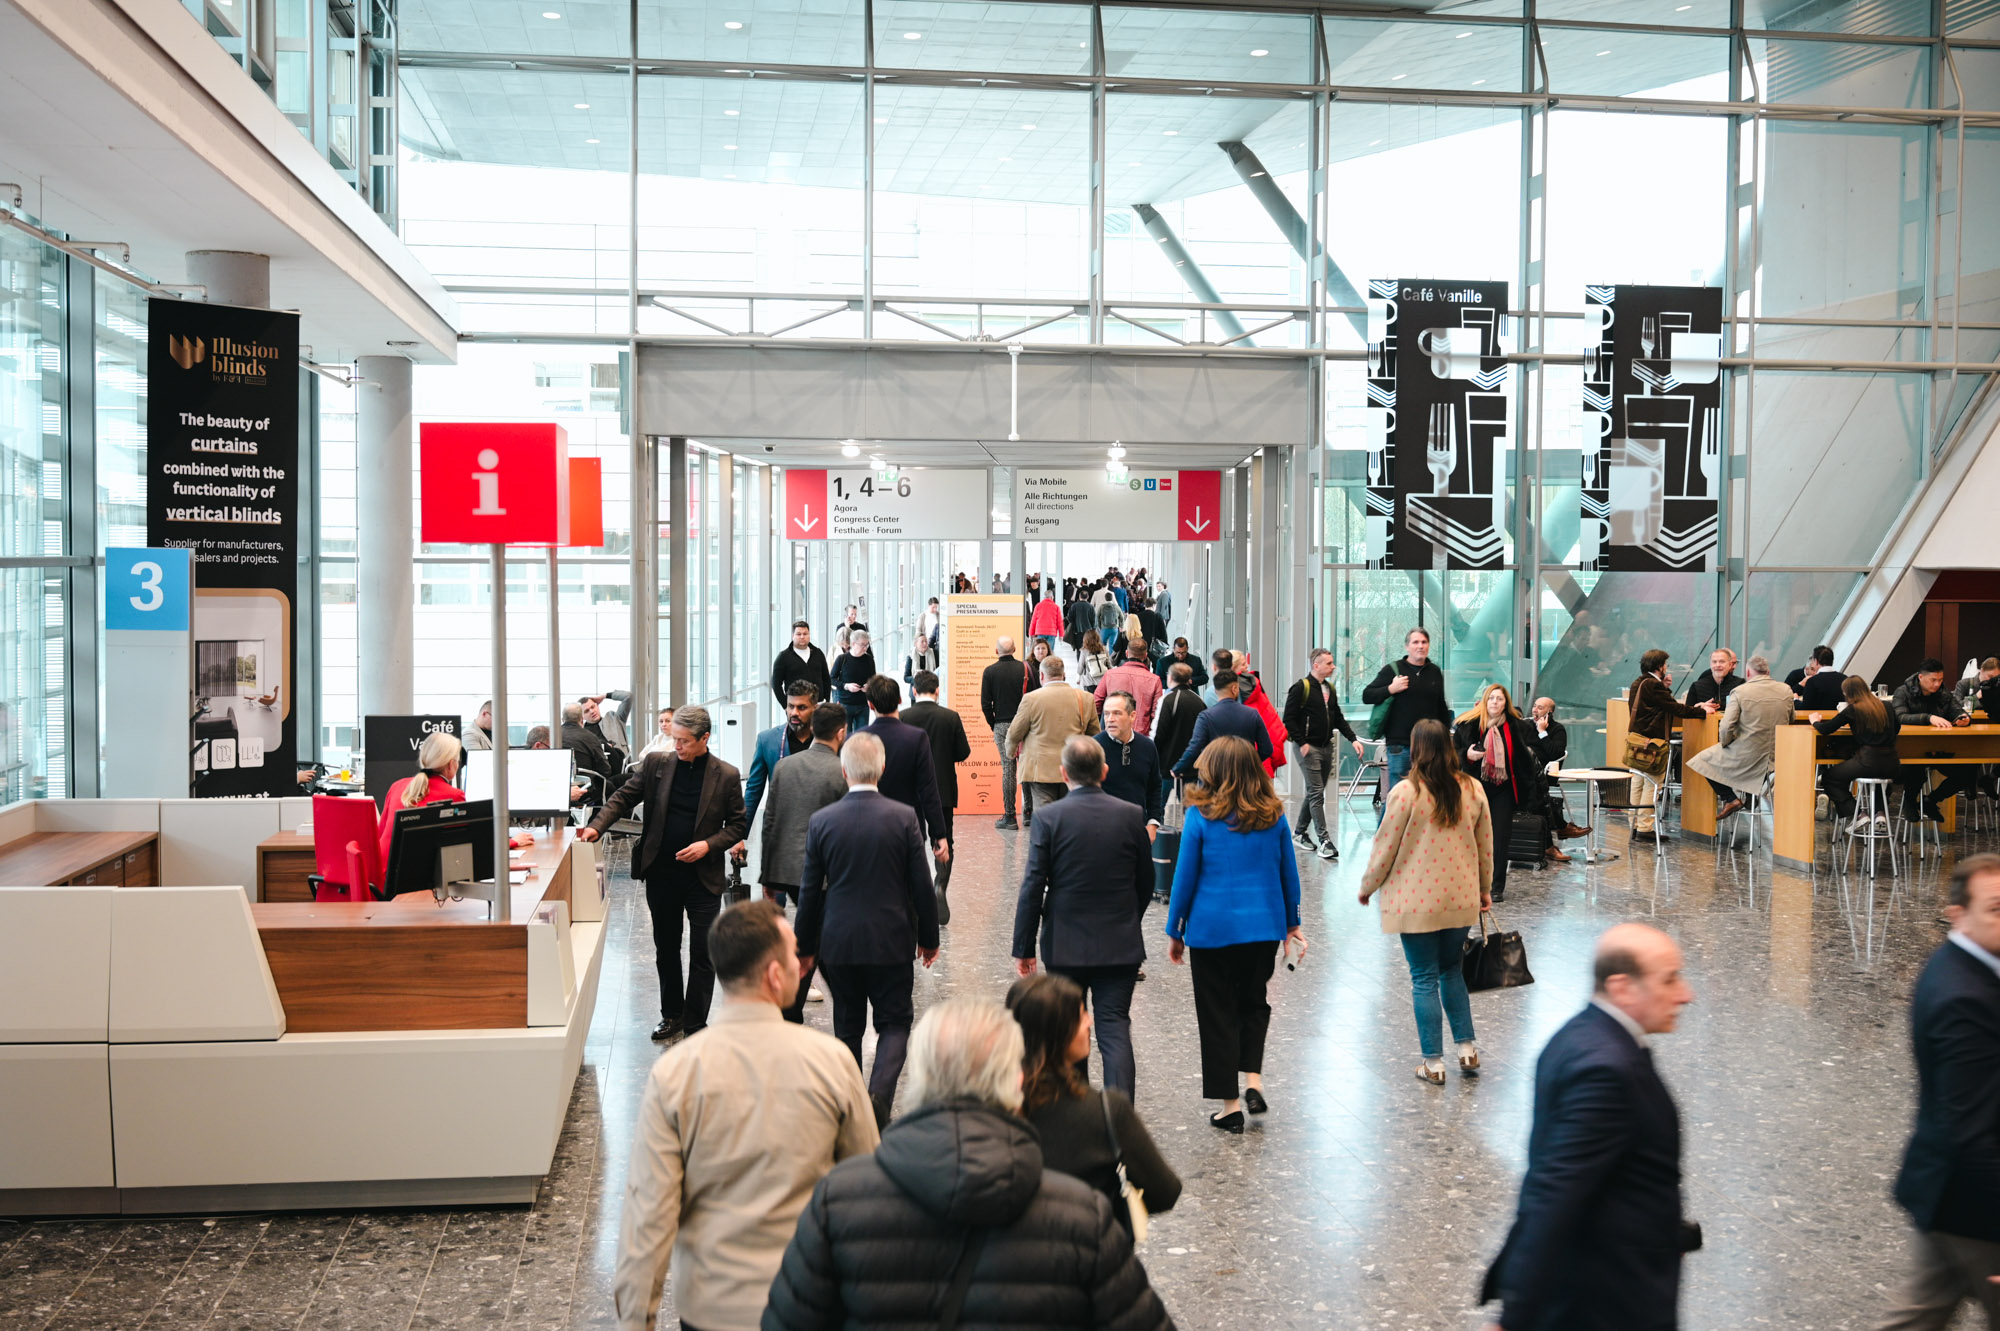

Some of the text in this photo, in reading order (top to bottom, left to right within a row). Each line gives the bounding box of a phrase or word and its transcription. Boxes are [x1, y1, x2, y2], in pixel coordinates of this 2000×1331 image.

[1402, 287, 1482, 303] Café Vanille
[212, 337, 279, 359] Illusion
[212, 355, 267, 376] blinds
[179, 412, 270, 432] The beauty of
[191, 437, 258, 453] curtains
[163, 462, 285, 480] combined with the
[1024, 478, 1067, 486] Via Mobile
[173, 481, 276, 500] functionality of
[1024, 492, 1088, 502] Alle Richtungen
[834, 504, 858, 513] Agora
[1024, 502, 1074, 510] All directions
[166, 506, 282, 523] vertical blinds
[834, 515, 900, 524] Congress Center
[1024, 517, 1060, 526] Ausgang
[834, 526, 870, 534] Festhalle
[876, 526, 902, 534] Forum
[1024, 526, 1039, 534] Exit
[164, 538, 284, 551] Supplier for manufacturers,
[195, 553, 280, 565] salers and projects.
[129, 561, 164, 611] 3
[421, 720, 454, 733] Café
[400, 814, 421, 822] Lenovo
